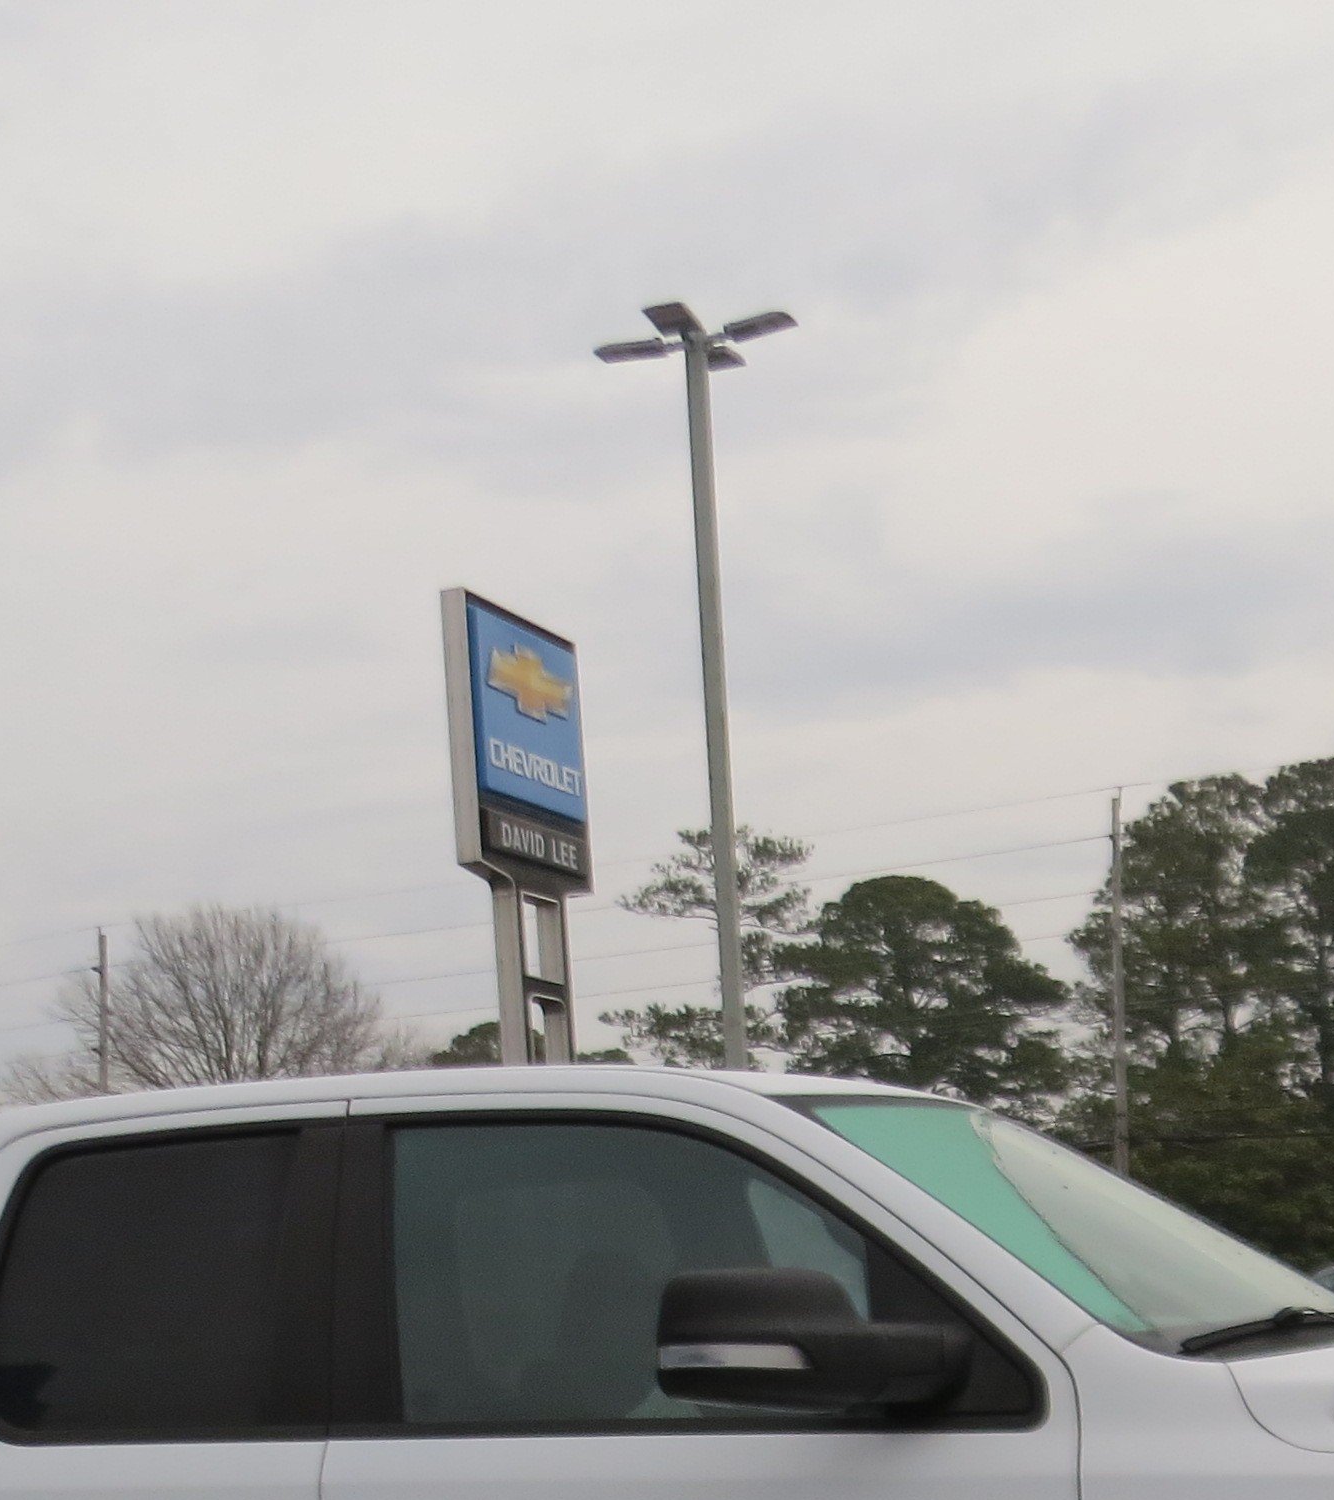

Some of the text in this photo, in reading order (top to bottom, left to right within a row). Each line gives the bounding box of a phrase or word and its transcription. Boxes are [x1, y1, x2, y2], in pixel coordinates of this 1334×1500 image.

[489, 738, 582, 797] CHEVROLET
[501, 822, 579, 870] DAVID LEE
